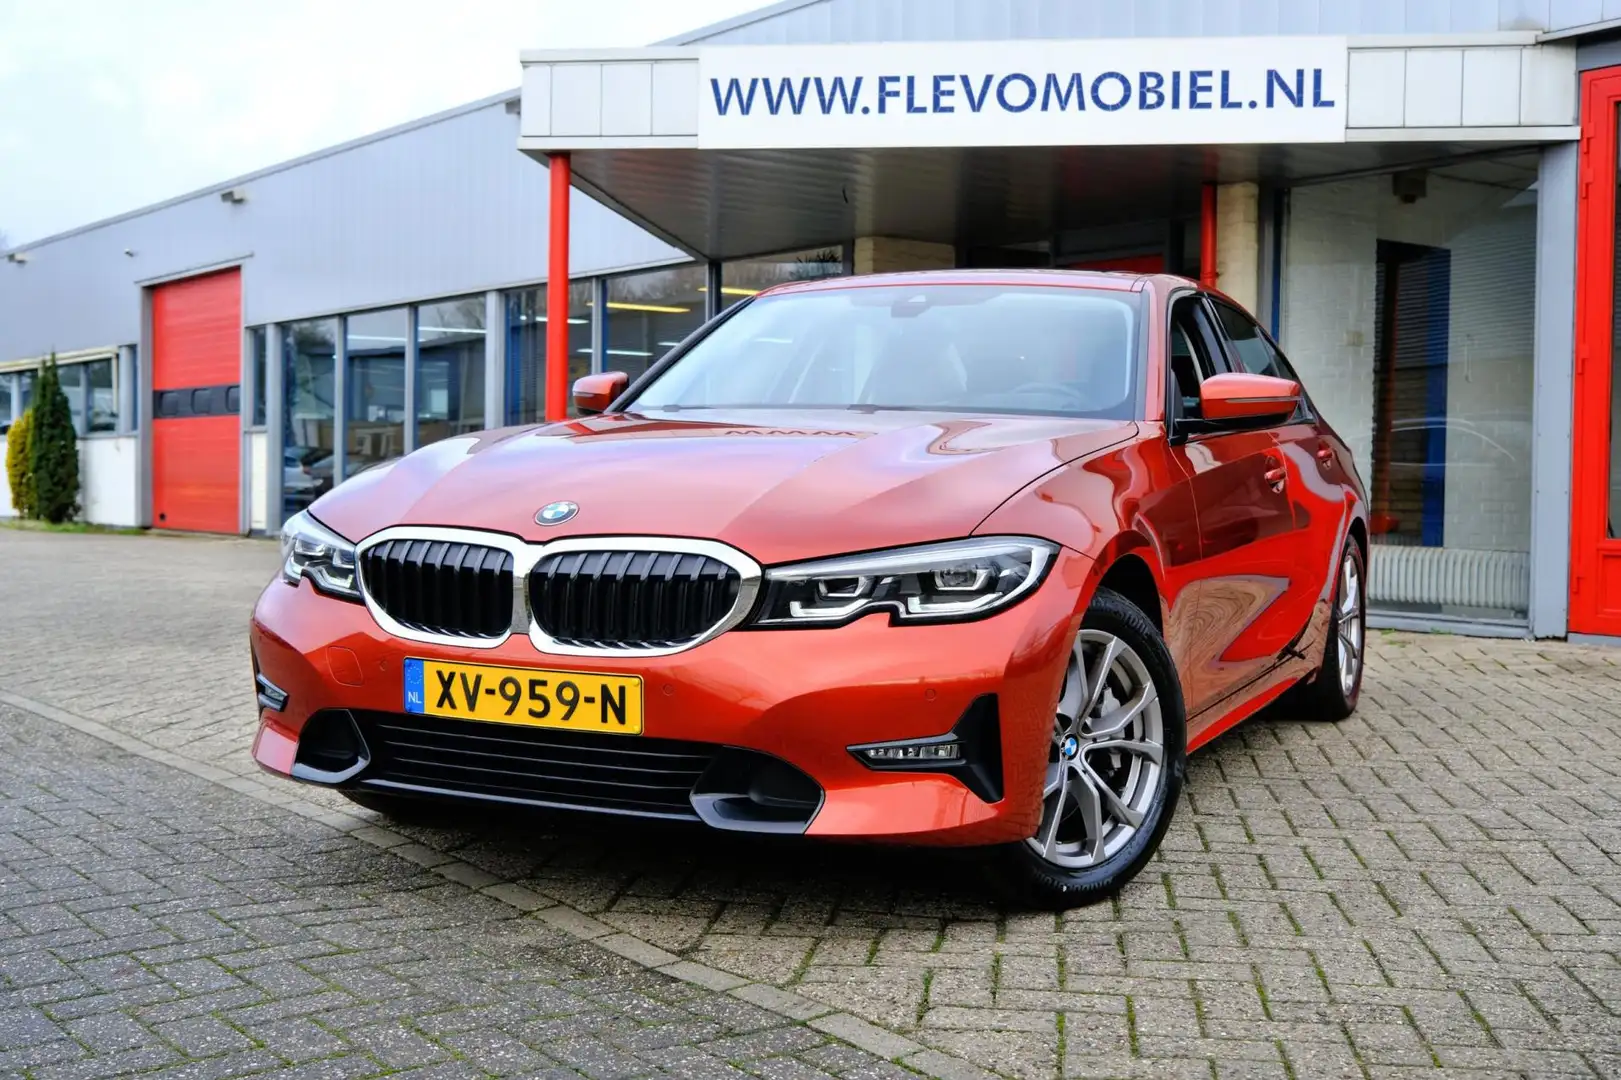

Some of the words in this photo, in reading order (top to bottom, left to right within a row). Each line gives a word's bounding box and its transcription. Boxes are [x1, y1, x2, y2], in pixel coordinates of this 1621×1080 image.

[710, 68, 1336, 116] WWW.FLEVOMOBIEL.NL
[407, 691, 423, 704] NL
[435, 669, 627, 726] XV-959-N
